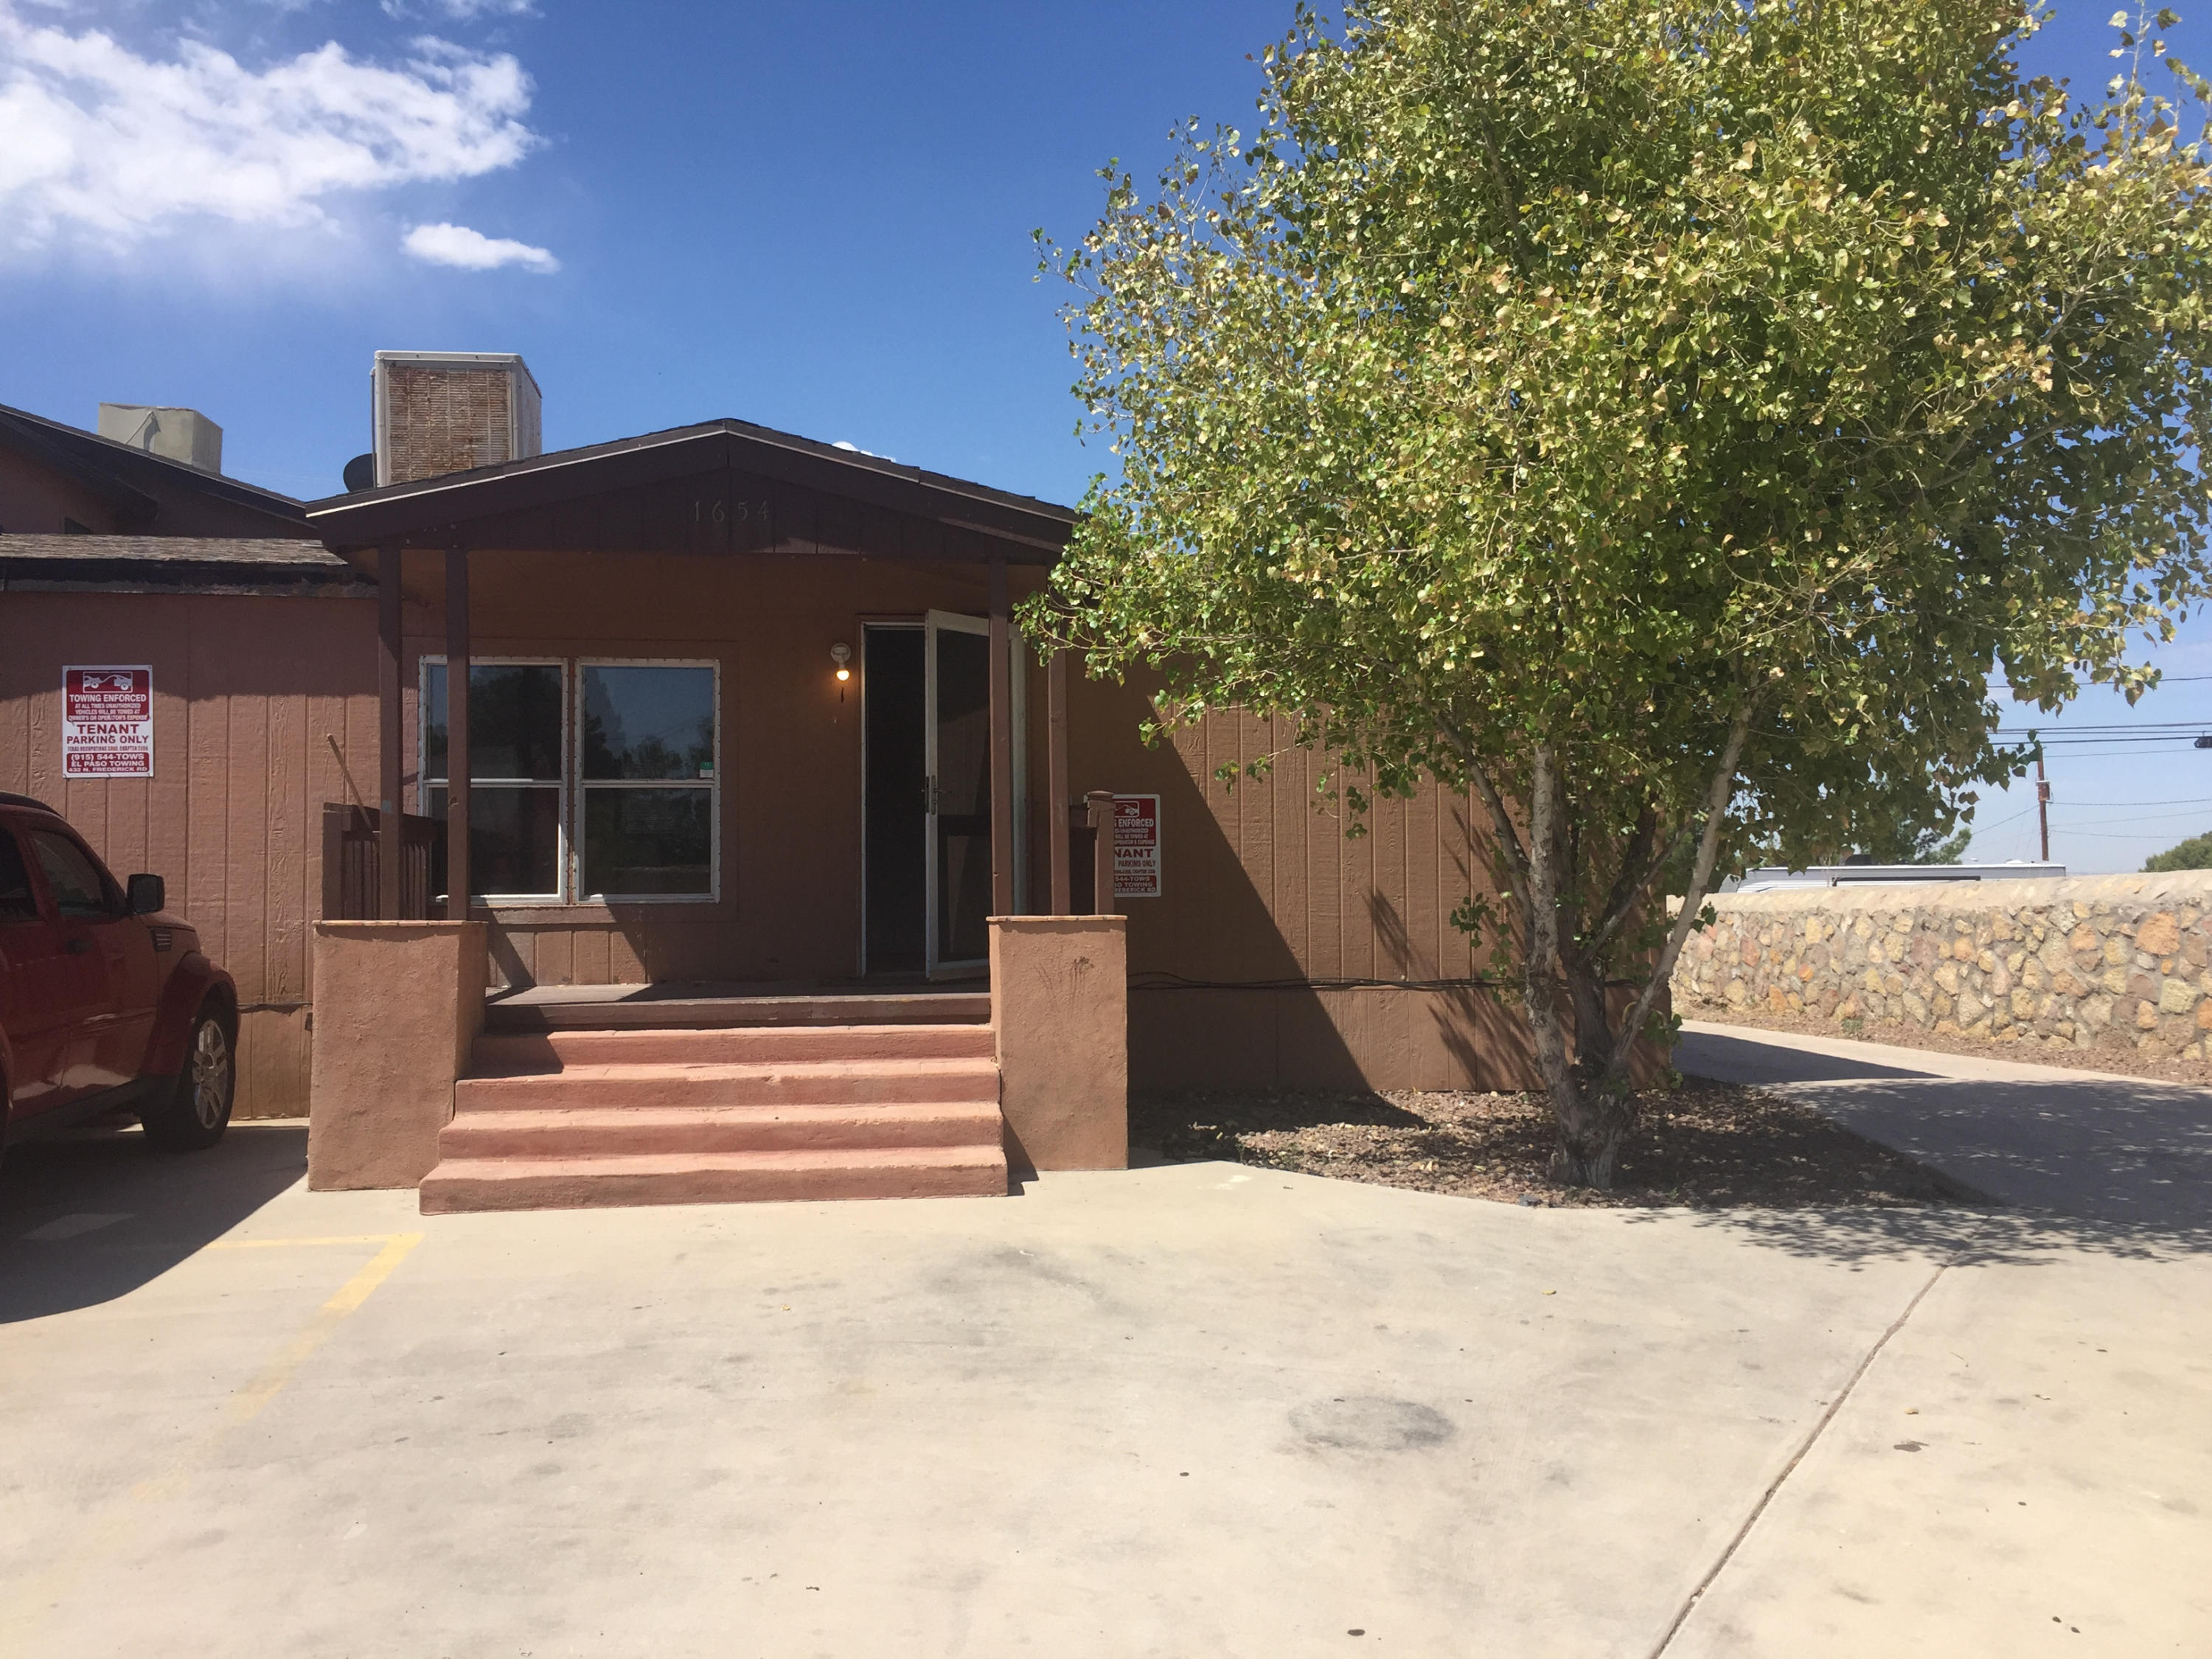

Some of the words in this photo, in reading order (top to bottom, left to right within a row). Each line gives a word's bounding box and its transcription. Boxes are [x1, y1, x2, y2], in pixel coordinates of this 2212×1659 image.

[695, 500, 769, 523] 1654
[69, 694, 102, 702] TOWING
[103, 694, 146, 702] ENFORCED
[77, 724, 139, 734] TENANT
[66, 735, 116, 744] PARKING
[119, 735, 149, 743] ONLY
[1118, 818, 1154, 827] ENFORCED
[1114, 849, 1153, 858] NANT
